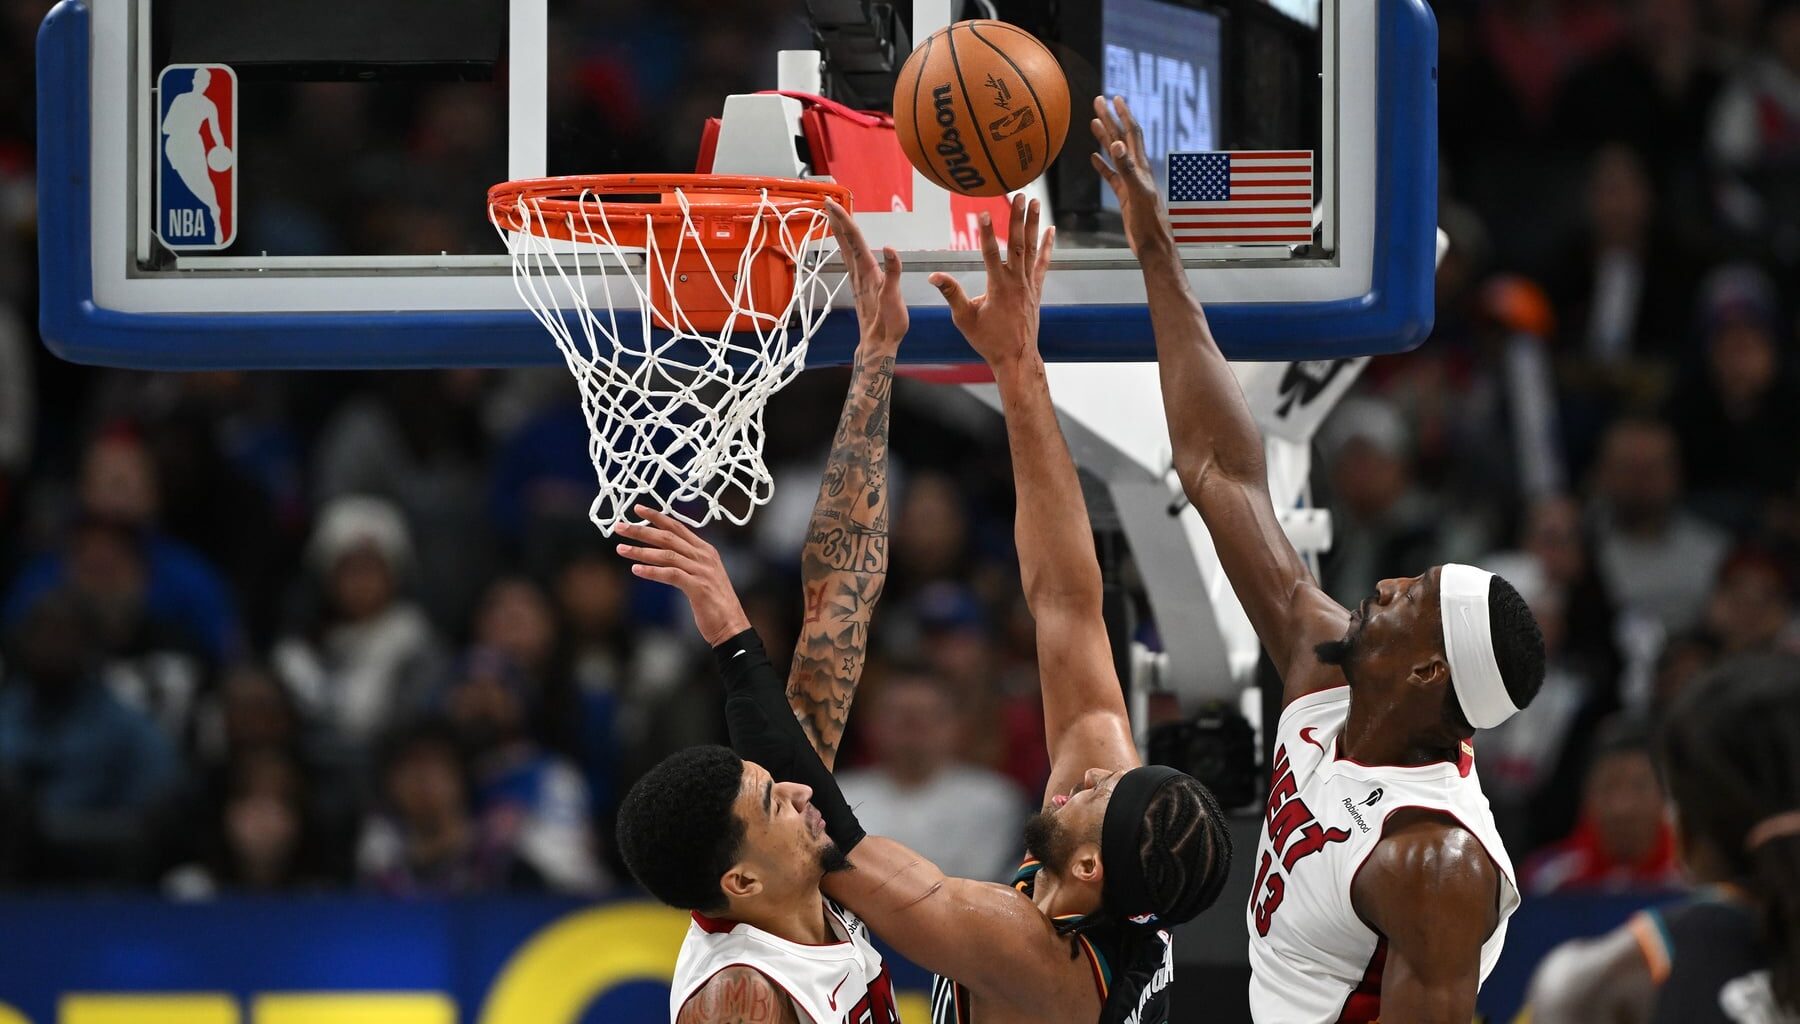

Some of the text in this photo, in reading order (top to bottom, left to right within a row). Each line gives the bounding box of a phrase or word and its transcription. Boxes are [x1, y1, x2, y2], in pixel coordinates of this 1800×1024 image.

[932, 82, 986, 193] Wilson
[168, 208, 206, 238] NBA
[1266, 743, 1351, 875] HEAT
[1342, 797, 1371, 834] Robinhood
[1250, 849, 1285, 938] 13
